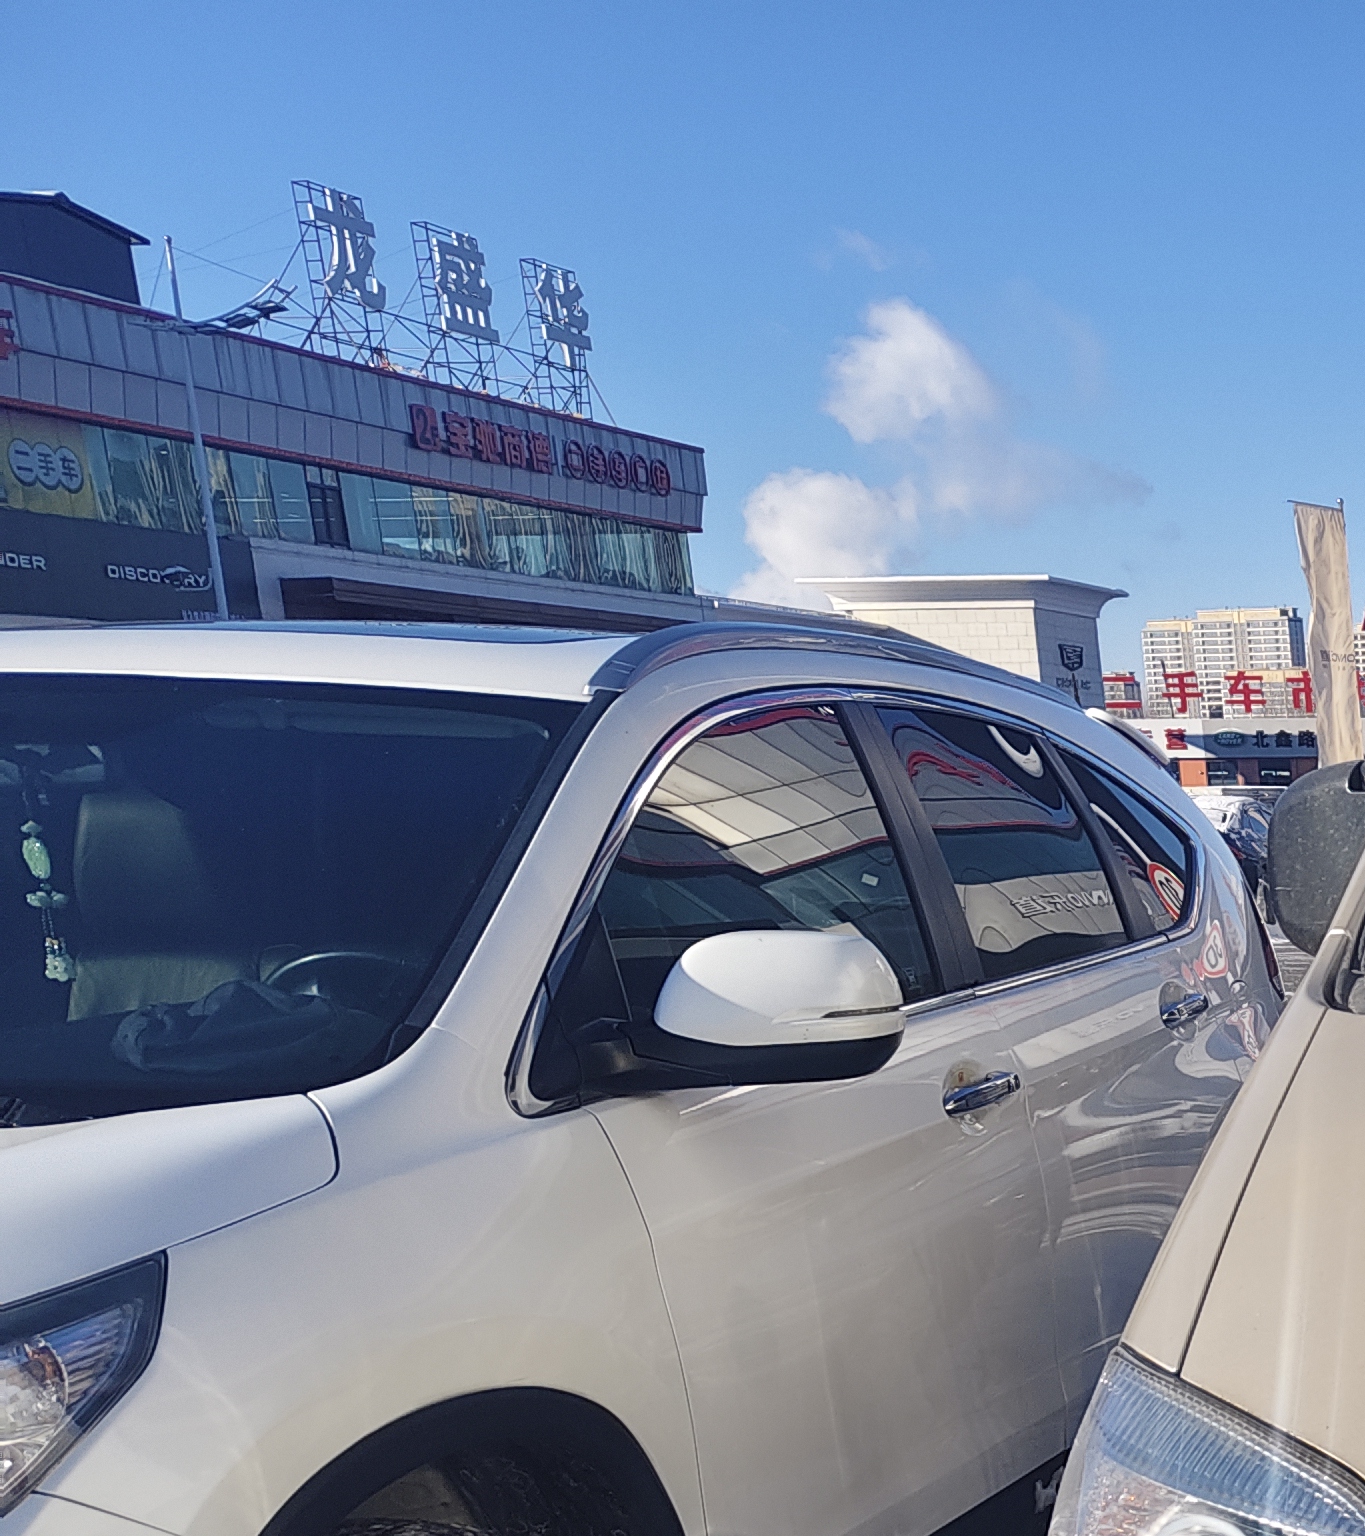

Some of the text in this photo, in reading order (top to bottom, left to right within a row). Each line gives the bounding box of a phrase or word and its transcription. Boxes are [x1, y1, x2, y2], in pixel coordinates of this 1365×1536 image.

[307, 187, 593, 367] 龙盛华
[13, 448, 80, 482] 二手车
